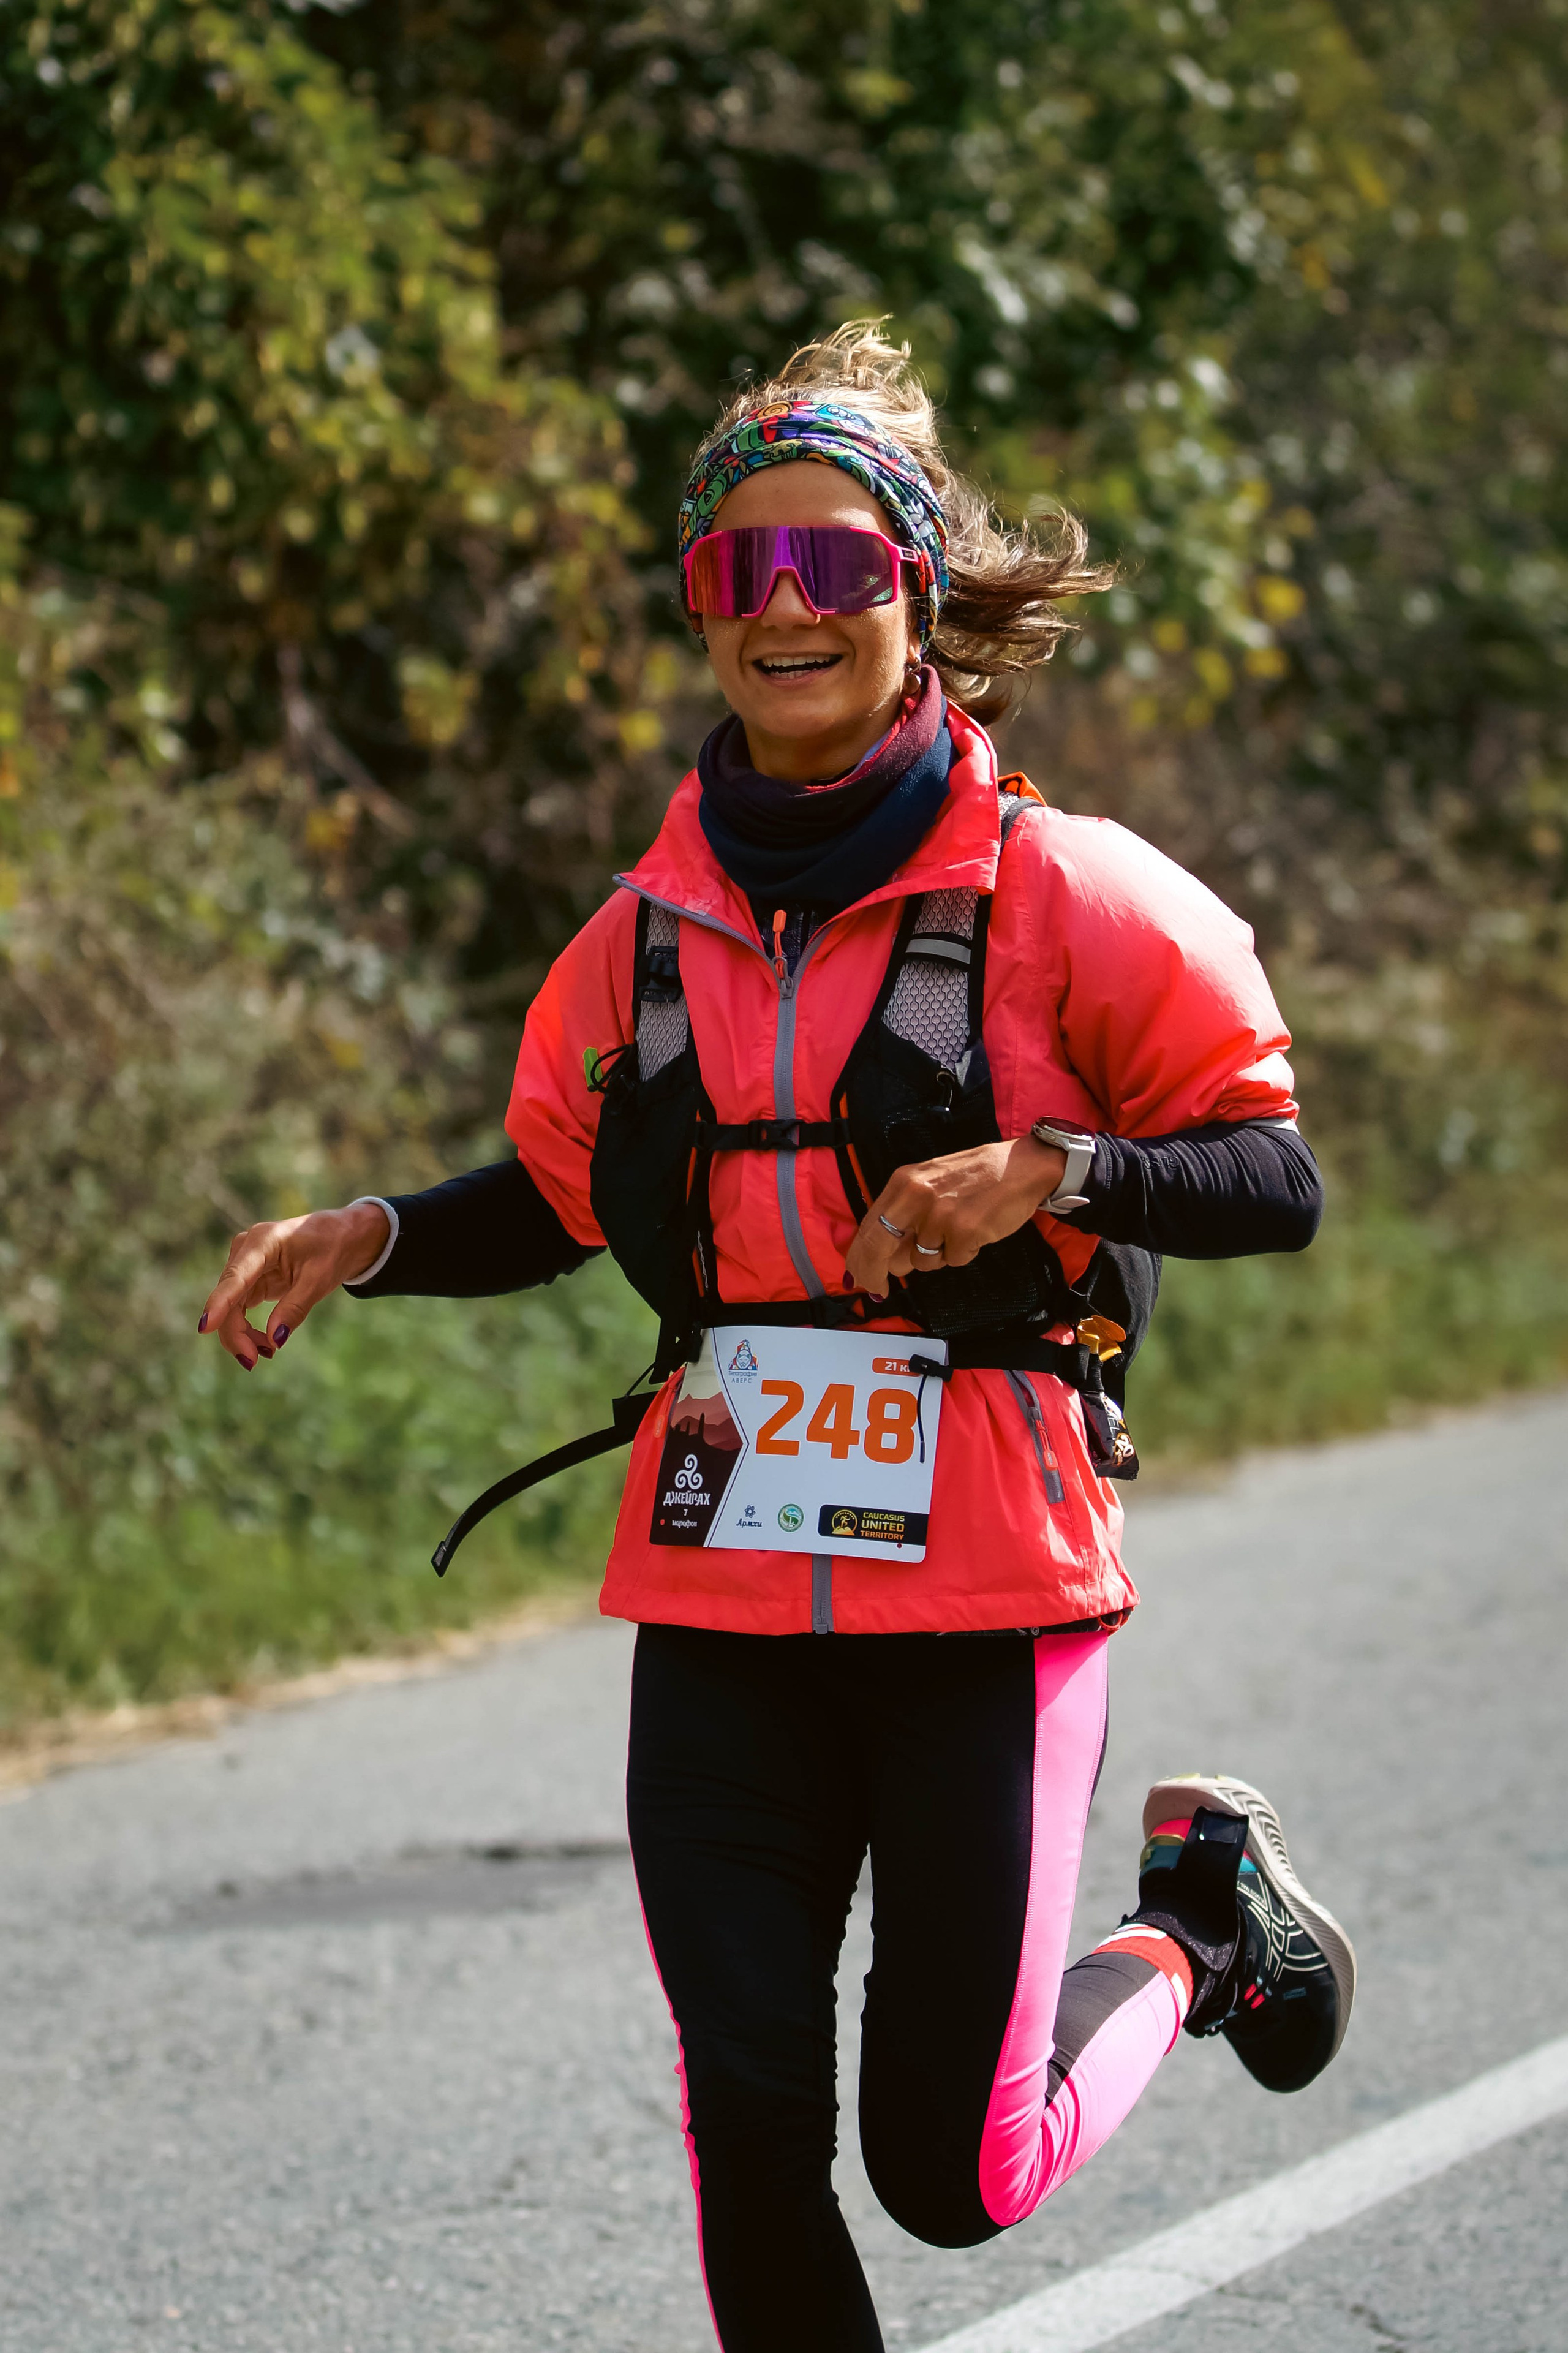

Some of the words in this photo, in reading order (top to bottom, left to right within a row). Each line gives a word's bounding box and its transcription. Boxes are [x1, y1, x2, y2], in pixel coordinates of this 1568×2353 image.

[884, 1361, 897, 1372] 21
[756, 1380, 918, 1464] 248
[663, 1490, 711, 1506] ДЖЕЙРАХ
[863, 1512, 905, 1522] CAUCASUS
[736, 1518, 763, 1528] Армхи
[861, 1520, 905, 1532] UNITED
[860, 1530, 904, 1540] TERRITORY
